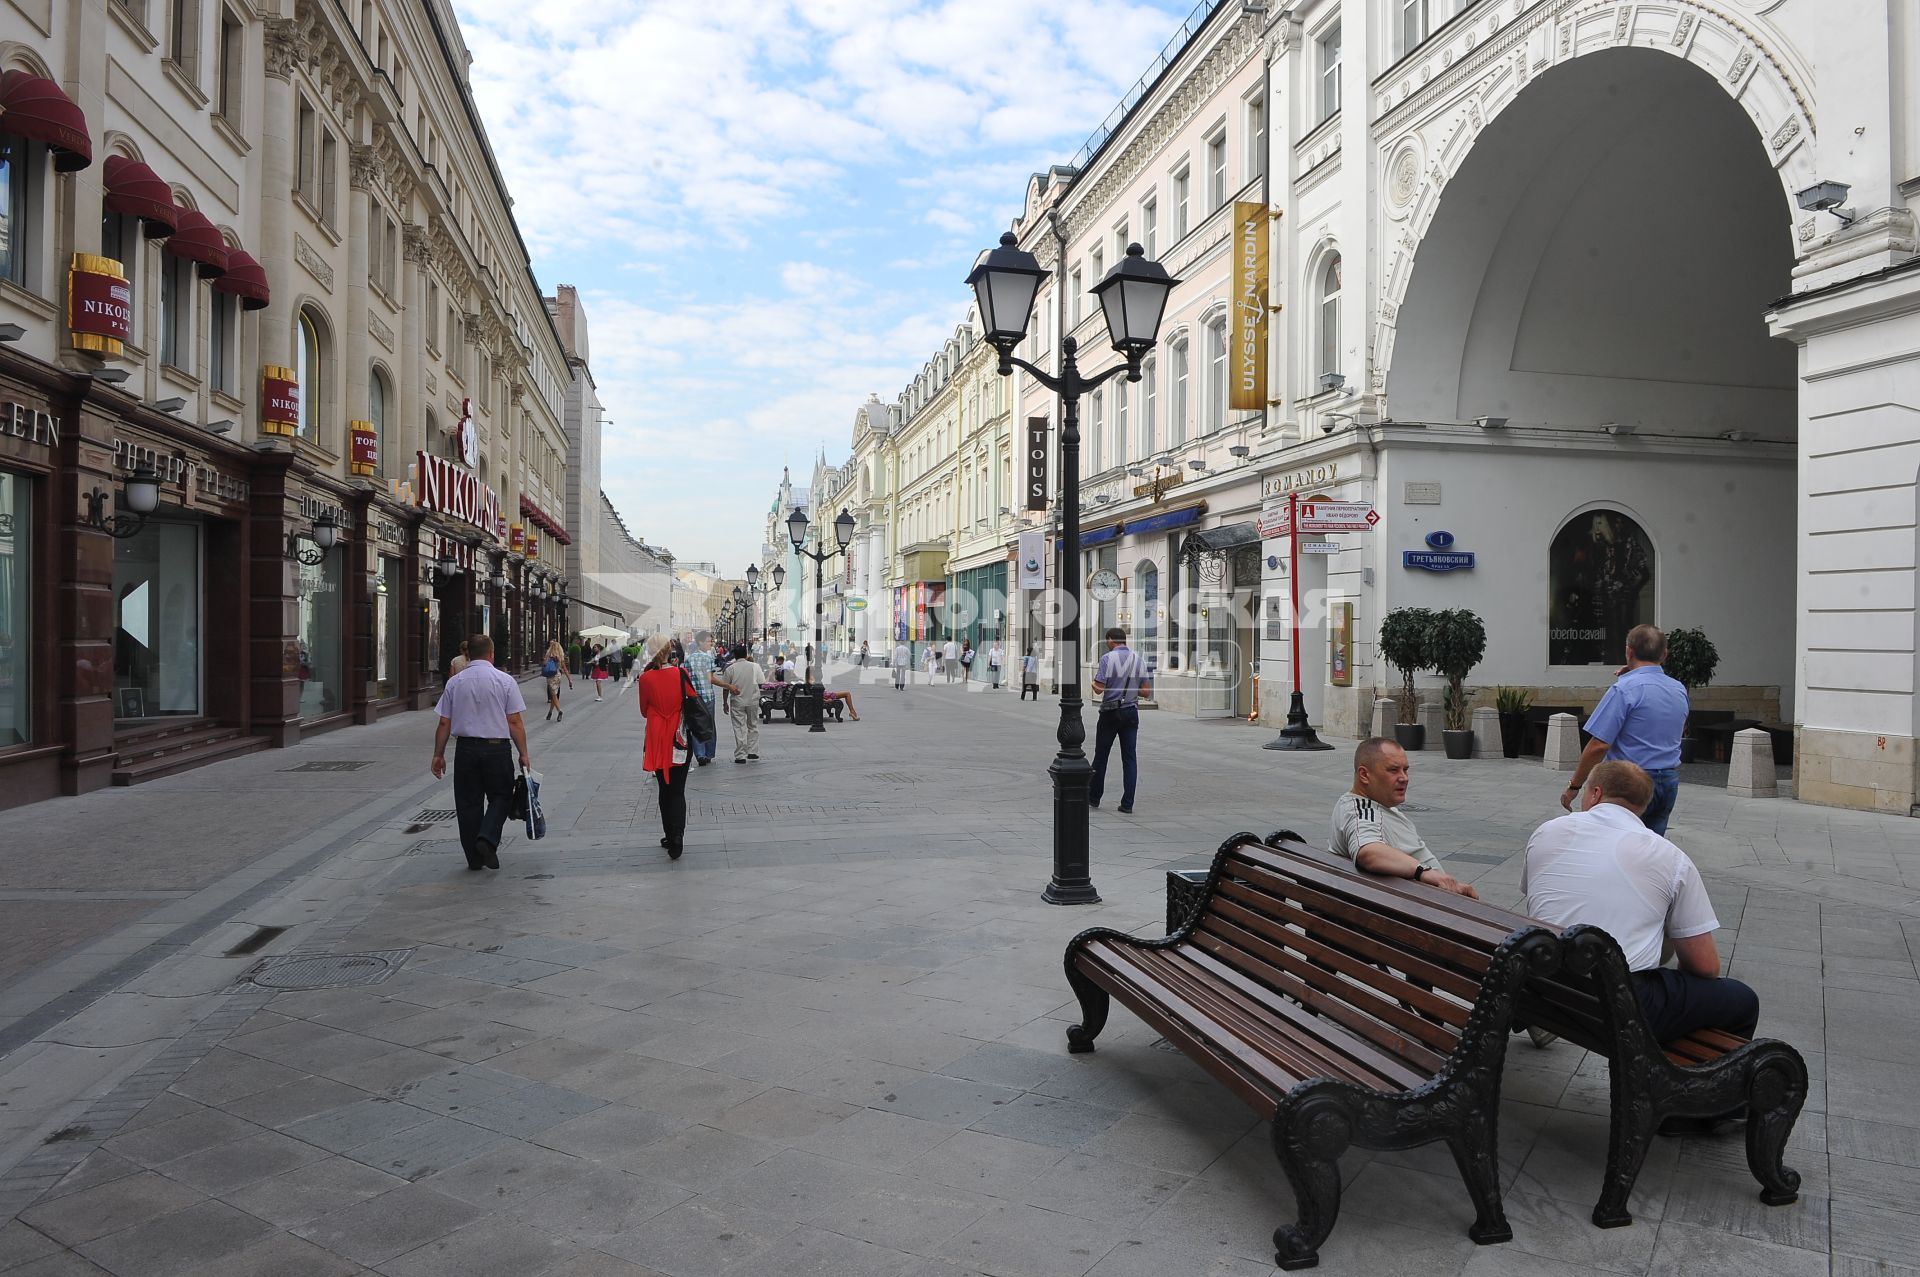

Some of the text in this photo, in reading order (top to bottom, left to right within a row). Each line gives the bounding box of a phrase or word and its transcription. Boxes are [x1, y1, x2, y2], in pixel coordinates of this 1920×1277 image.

[1243, 221, 1257, 391] ULYSSE NARDIN
[0, 402, 60, 448] EIN
[1031, 430, 1045, 497] TOUS
[1265, 463, 1338, 495] ROMANOV
[1439, 534, 1444, 545] 1
[1411, 555, 1469, 565] ТРЕТЬЯКОВСКИЙ
